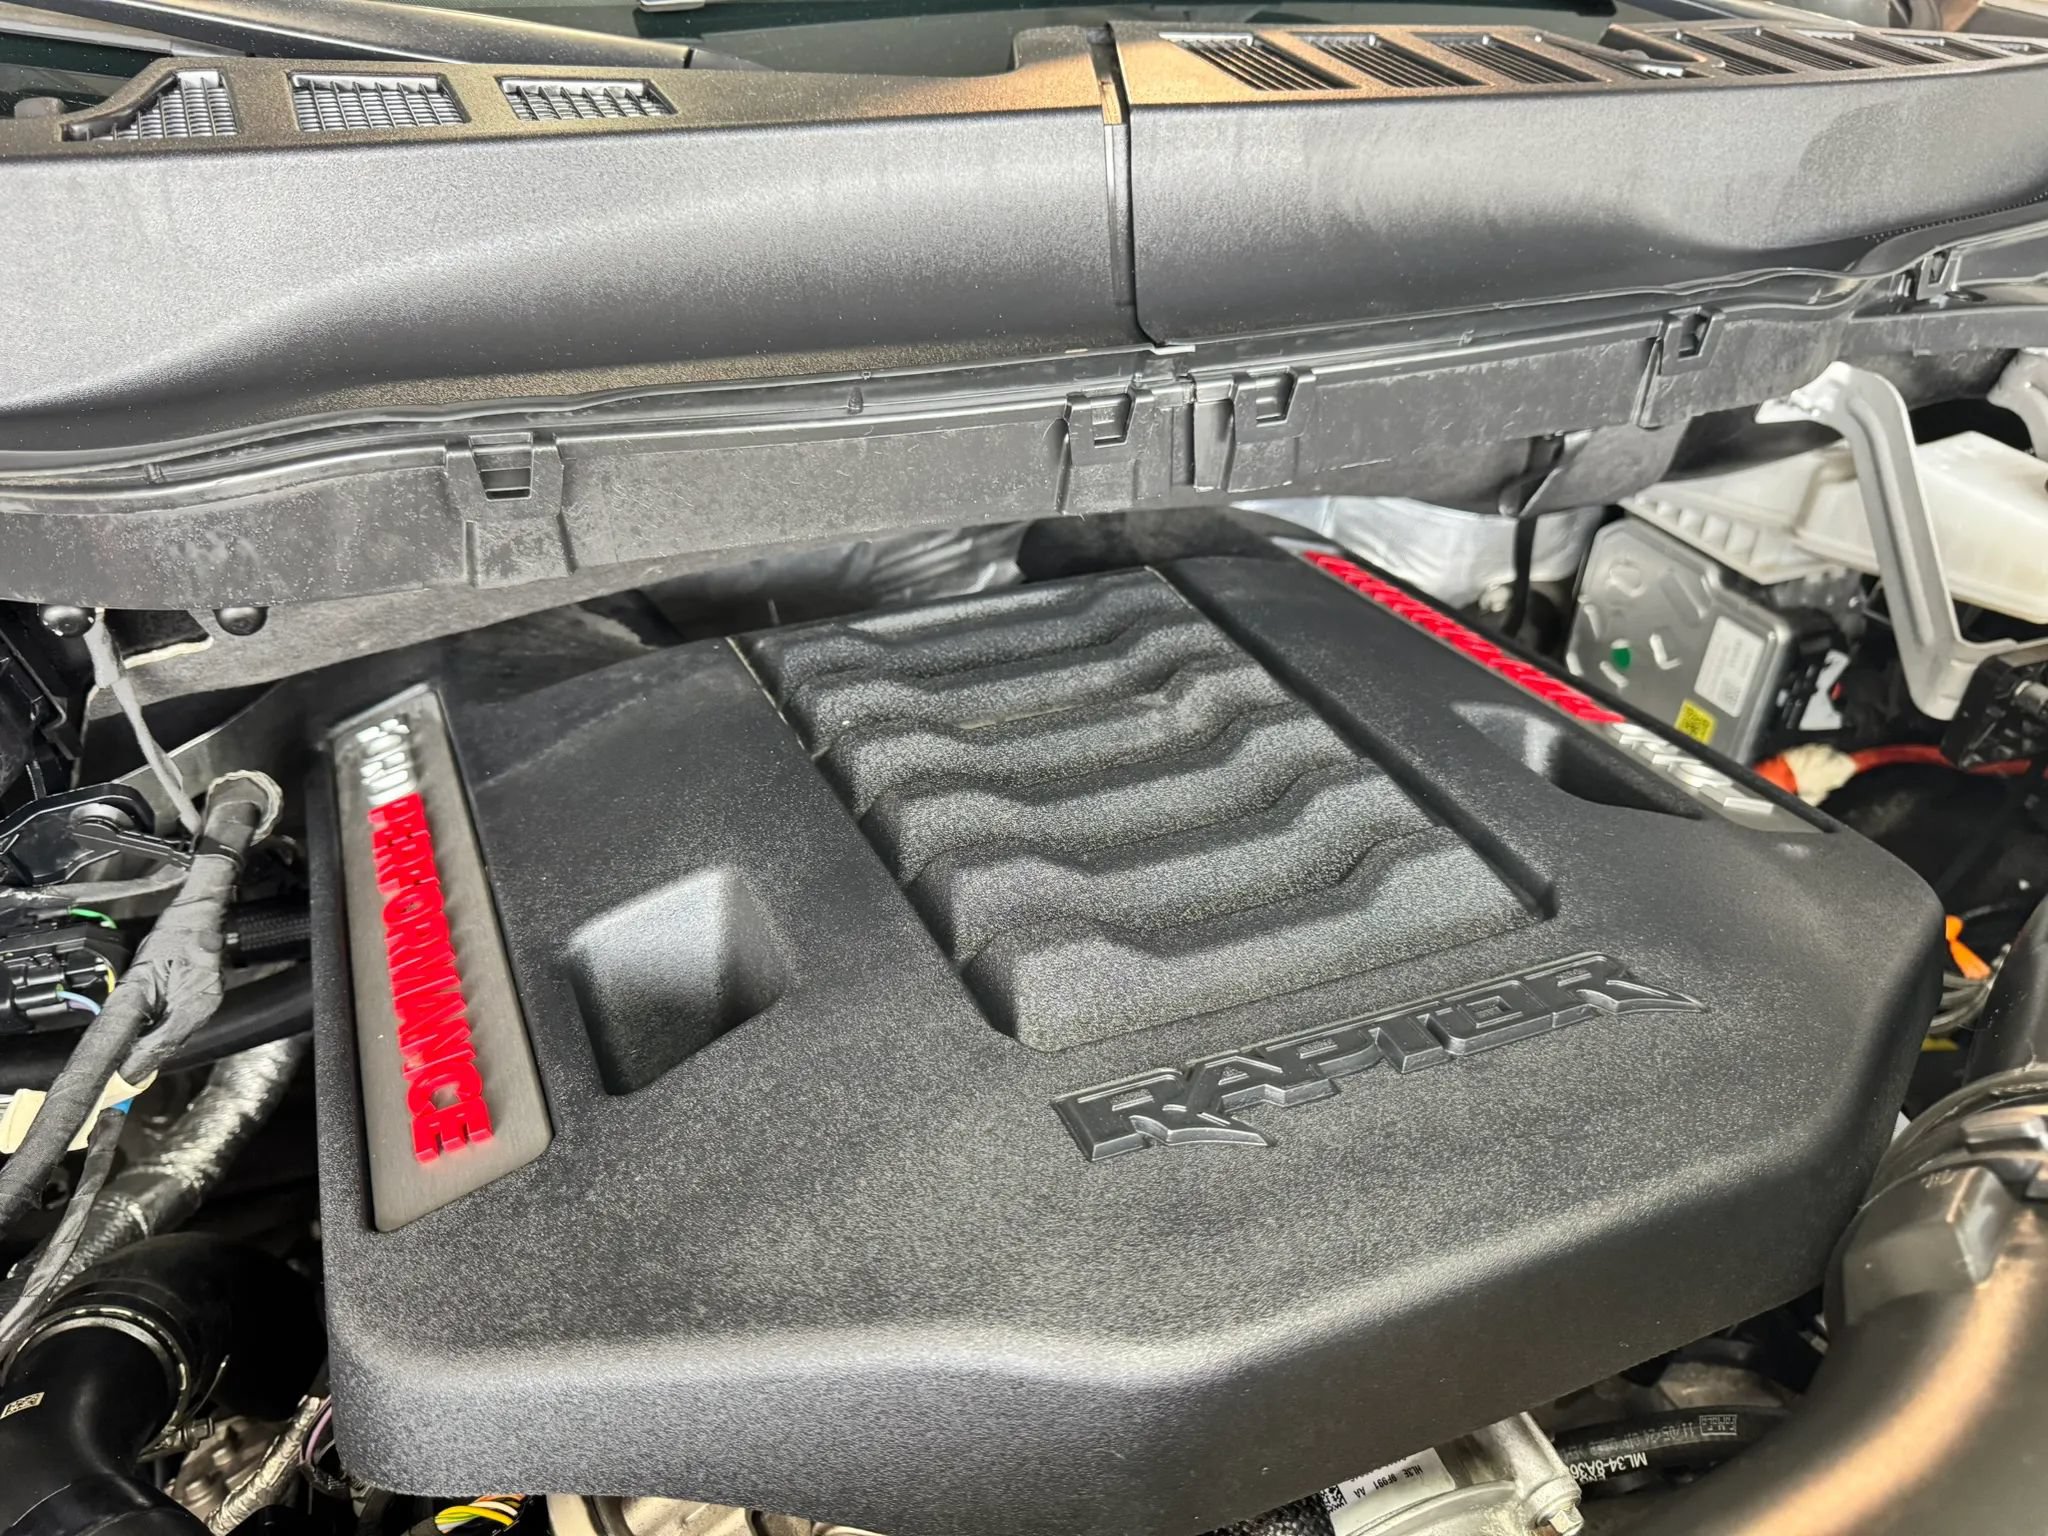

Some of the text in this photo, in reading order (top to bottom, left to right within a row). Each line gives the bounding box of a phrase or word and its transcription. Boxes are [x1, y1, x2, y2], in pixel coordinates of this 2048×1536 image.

[368, 792, 495, 1164] PERFORMANCE
[1051, 951, 1708, 1161] RAPTOR
[1353, 1486, 1367, 1499] AA
